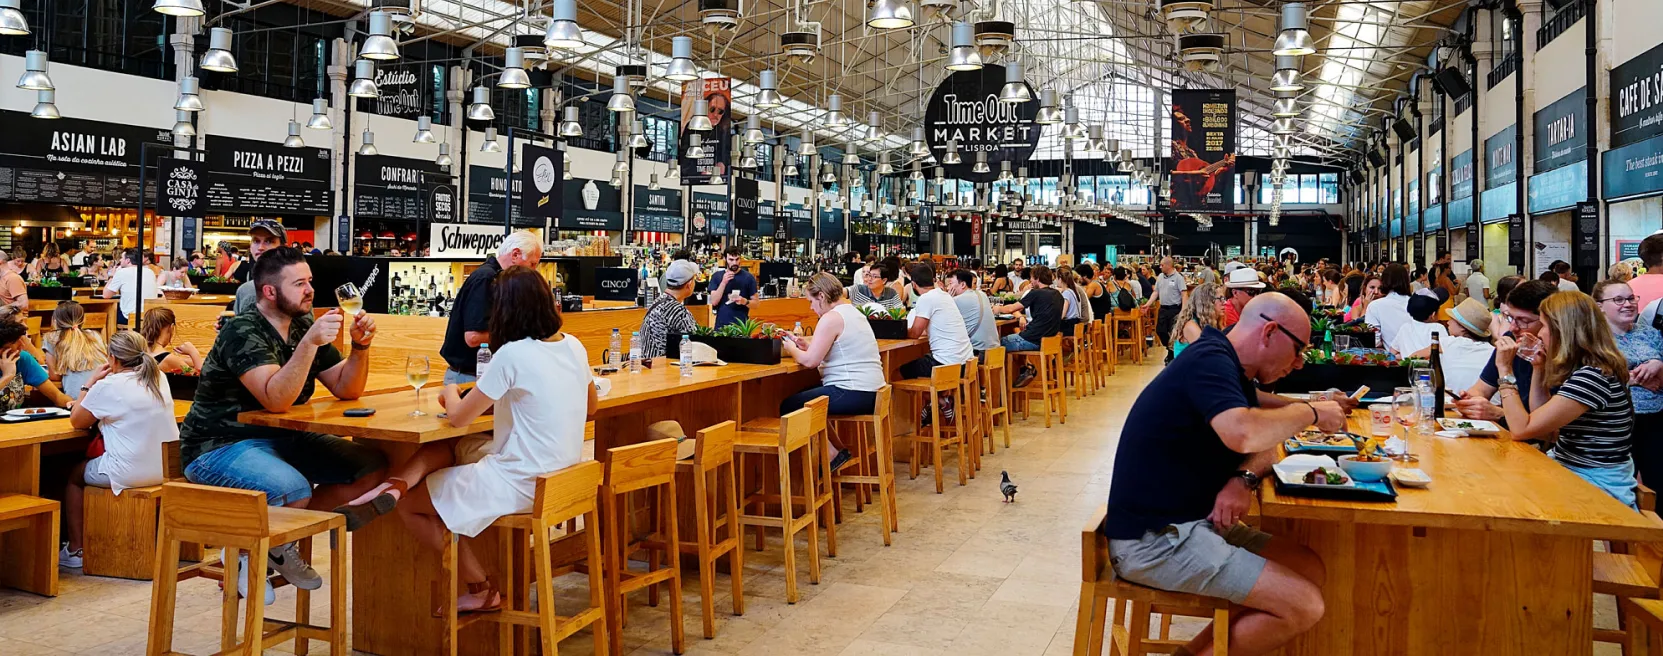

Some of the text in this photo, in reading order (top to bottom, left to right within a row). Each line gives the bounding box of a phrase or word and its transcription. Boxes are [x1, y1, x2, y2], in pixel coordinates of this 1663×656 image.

[375, 69, 417, 87] Estúdio
[1619, 76, 1638, 118] CAFÉ
[1640, 76, 1651, 111] DE
[944, 94, 1018, 124] Time Out
[934, 126, 1031, 142] MARKET
[51, 131, 126, 157] ASIAN LAB
[234, 151, 304, 173] PIZZA A PEZZI
[166, 187, 198, 198] GINJA
[167, 180, 193, 189] CASA
[490, 177, 522, 193] HONOATO
[736, 198, 755, 209] CINCO
[601, 280, 628, 288] CINCO
